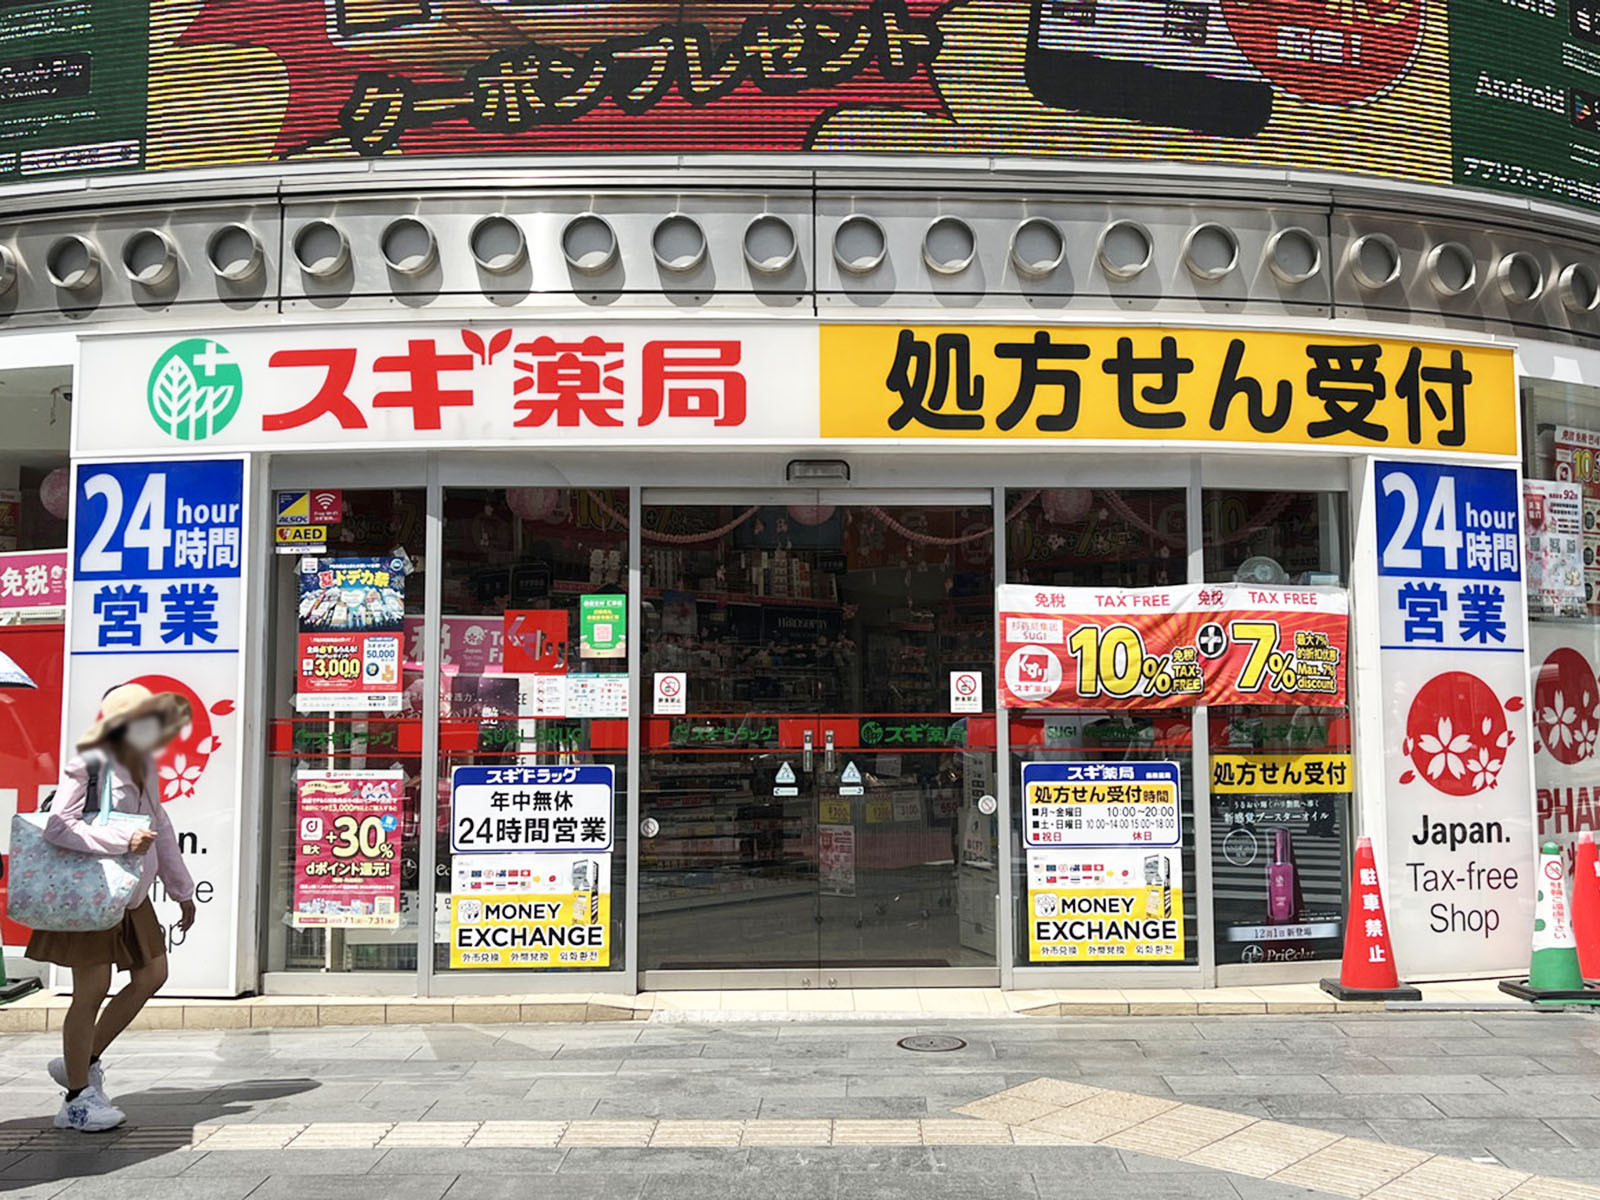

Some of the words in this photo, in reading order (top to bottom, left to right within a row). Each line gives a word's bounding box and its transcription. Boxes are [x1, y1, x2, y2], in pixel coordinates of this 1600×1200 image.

[1475, 71, 1565, 114] Android
[262, 328, 747, 431] スギ薬局
[886, 329, 1473, 446] 処方せん受付
[80, 473, 171, 573] 24
[177, 498, 239, 524] hour
[292, 528, 323, 540] AED
[1382, 472, 1464, 570] 24
[1465, 502, 1517, 530] hour
[175, 527, 239, 569] 時間
[1466, 531, 1518, 573] 時間
[1, 565, 50, 598] 免税
[1094, 594, 1126, 608] TAX
[1133, 594, 1171, 607] FREE
[1248, 591, 1281, 605] TAX
[1283, 592, 1318, 605] FREE
[93, 584, 219, 647] 営業
[1398, 582, 1507, 643] 営業
[1023, 632, 1047, 640] SUGI
[366, 649, 396, 659] 50,000
[1070, 625, 1171, 694] 10%
[1232, 622, 1296, 691] 7%
[314, 658, 361, 679] 3,000
[1173, 678, 1201, 691] FREE
[486, 767, 580, 784] スギドラッグ
[1067, 764, 1135, 780] スギ薬局
[1213, 761, 1347, 786] 処方せん受付
[490, 790, 574, 812] 年中無休
[1034, 785, 1169, 804] 処方せん受付時間
[458, 816, 606, 845] 24時間営業
[1042, 832, 1062, 842] 祝日
[1132, 831, 1153, 841] 休日
[1412, 815, 1511, 852] Japan.
[1405, 860, 1519, 892] Tax-free
[485, 903, 561, 920] MONEY
[1061, 897, 1135, 914] MONEY
[1360, 868, 1387, 963] 駐車禁止
[1036, 920, 1177, 940] EXCHANGE
[1429, 902, 1500, 939] Shop
[458, 926, 603, 948] EXCHANGE
